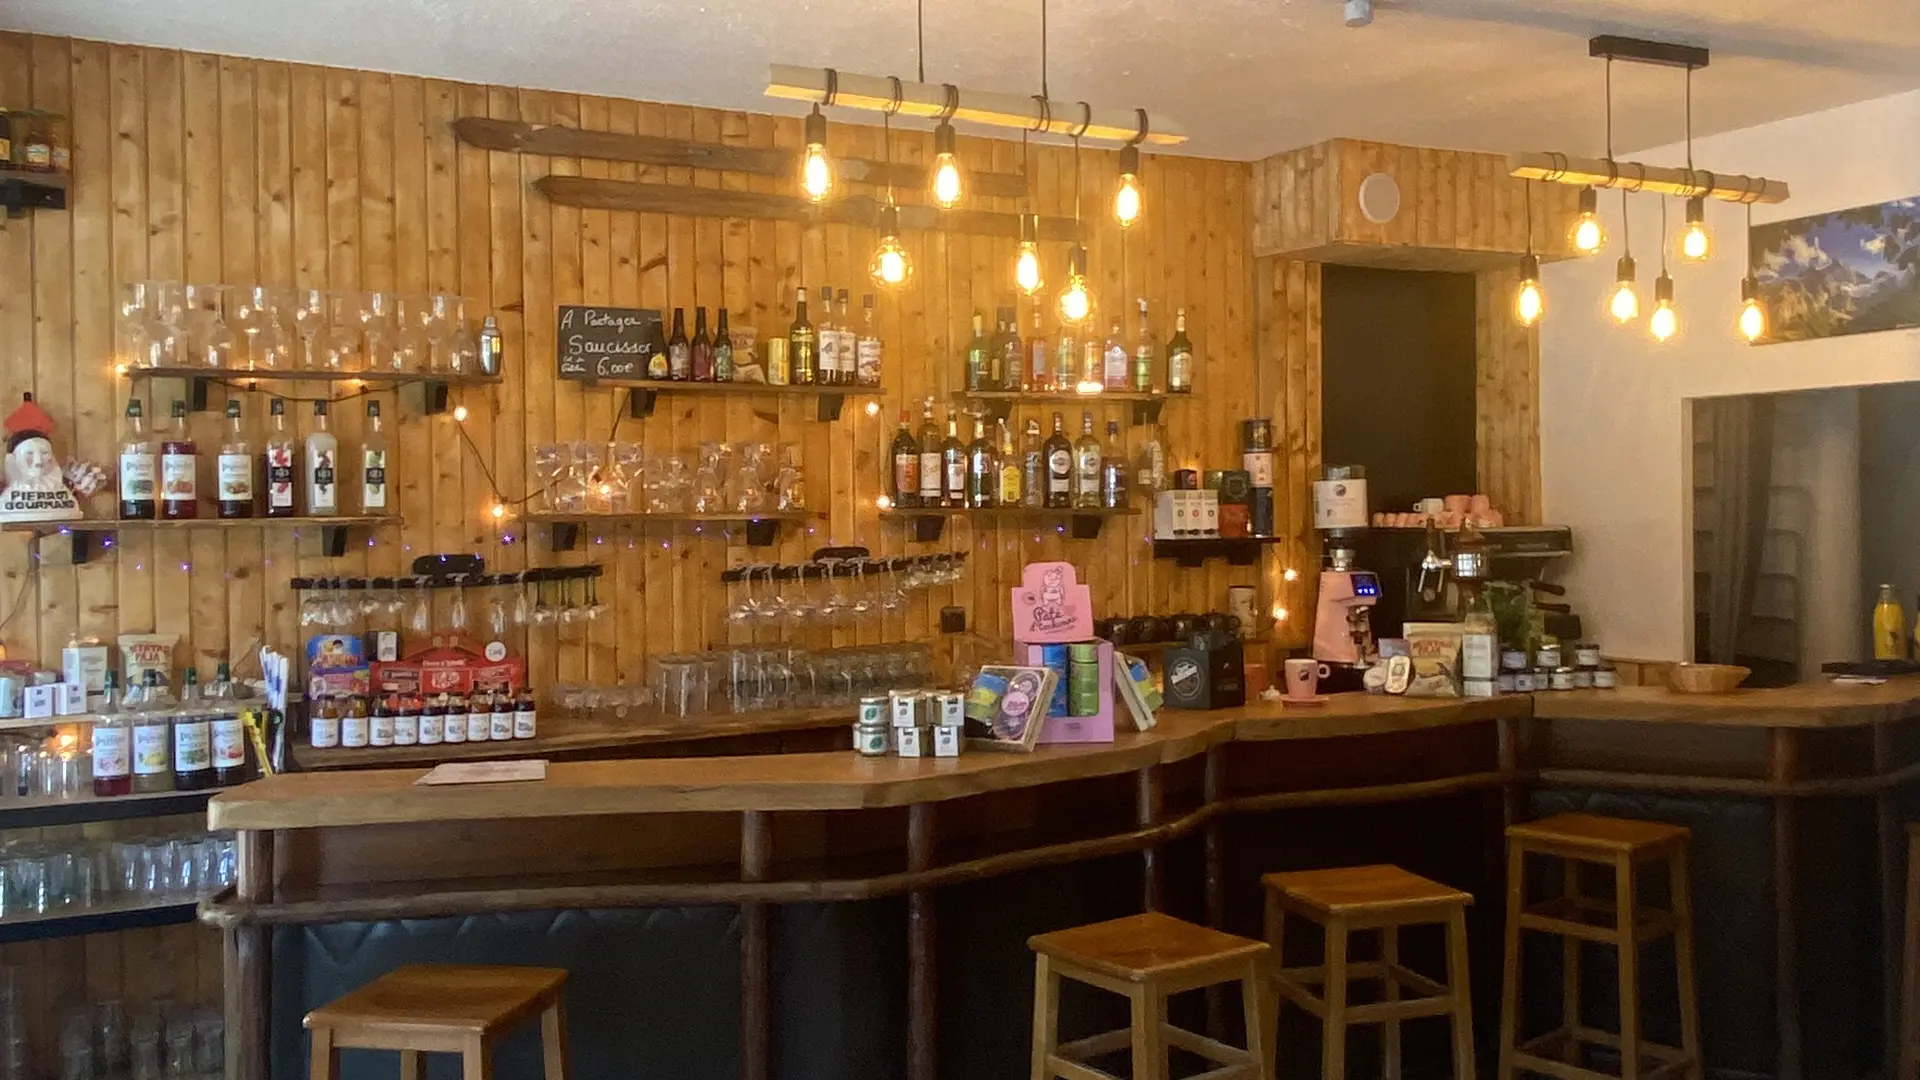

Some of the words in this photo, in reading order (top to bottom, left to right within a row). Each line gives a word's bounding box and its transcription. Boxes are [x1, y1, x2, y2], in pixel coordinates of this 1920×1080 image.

[568, 334, 652, 355] Saucisso
[10, 490, 69, 501] PIERROT
[4, 500, 75, 510] GOURMAND
